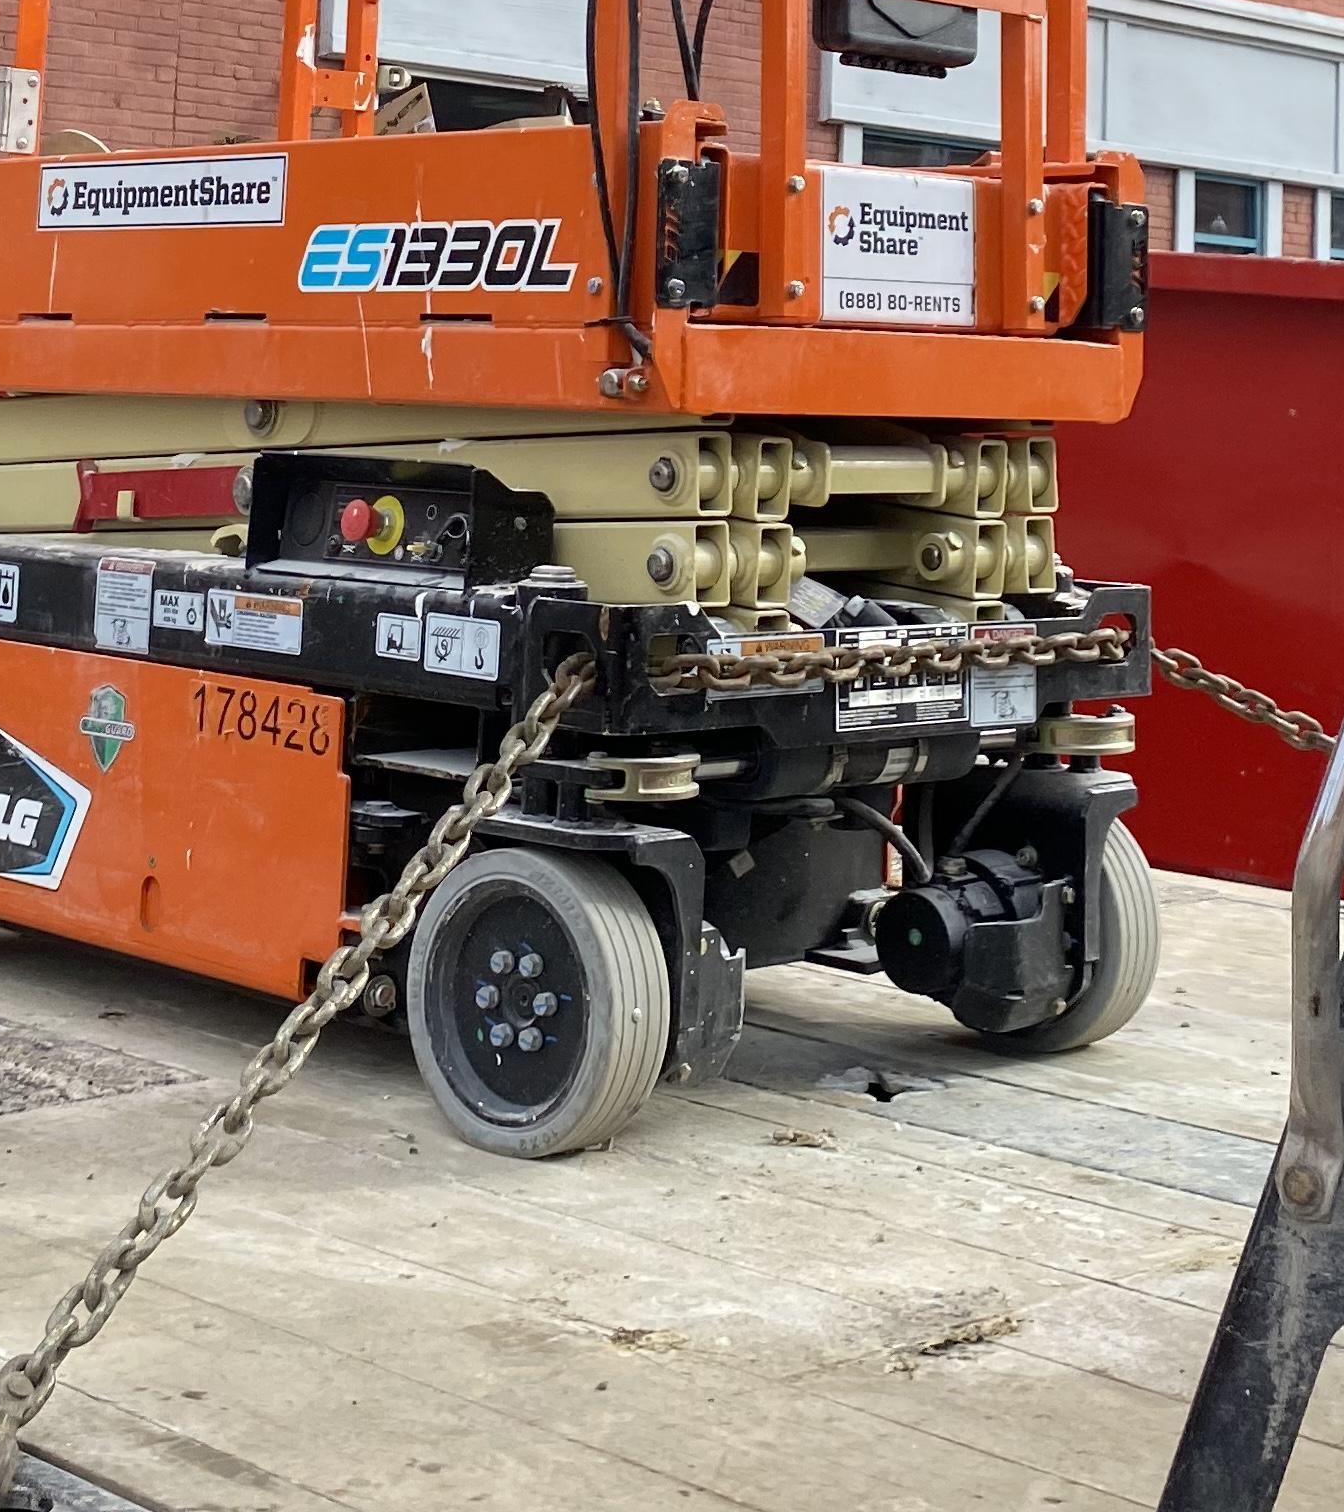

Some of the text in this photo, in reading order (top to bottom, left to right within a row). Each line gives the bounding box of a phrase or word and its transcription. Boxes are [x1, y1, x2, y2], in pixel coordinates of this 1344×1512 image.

[72, 176, 271, 216] EquipmentShare
[859, 202, 969, 233] Equipment
[299, 219, 578, 292] ES1330L
[859, 231, 919, 256] Share
[839, 290, 961, 313] (888) 80-RENTS
[160, 594, 179, 607] MAX
[192, 683, 330, 756] 178428
